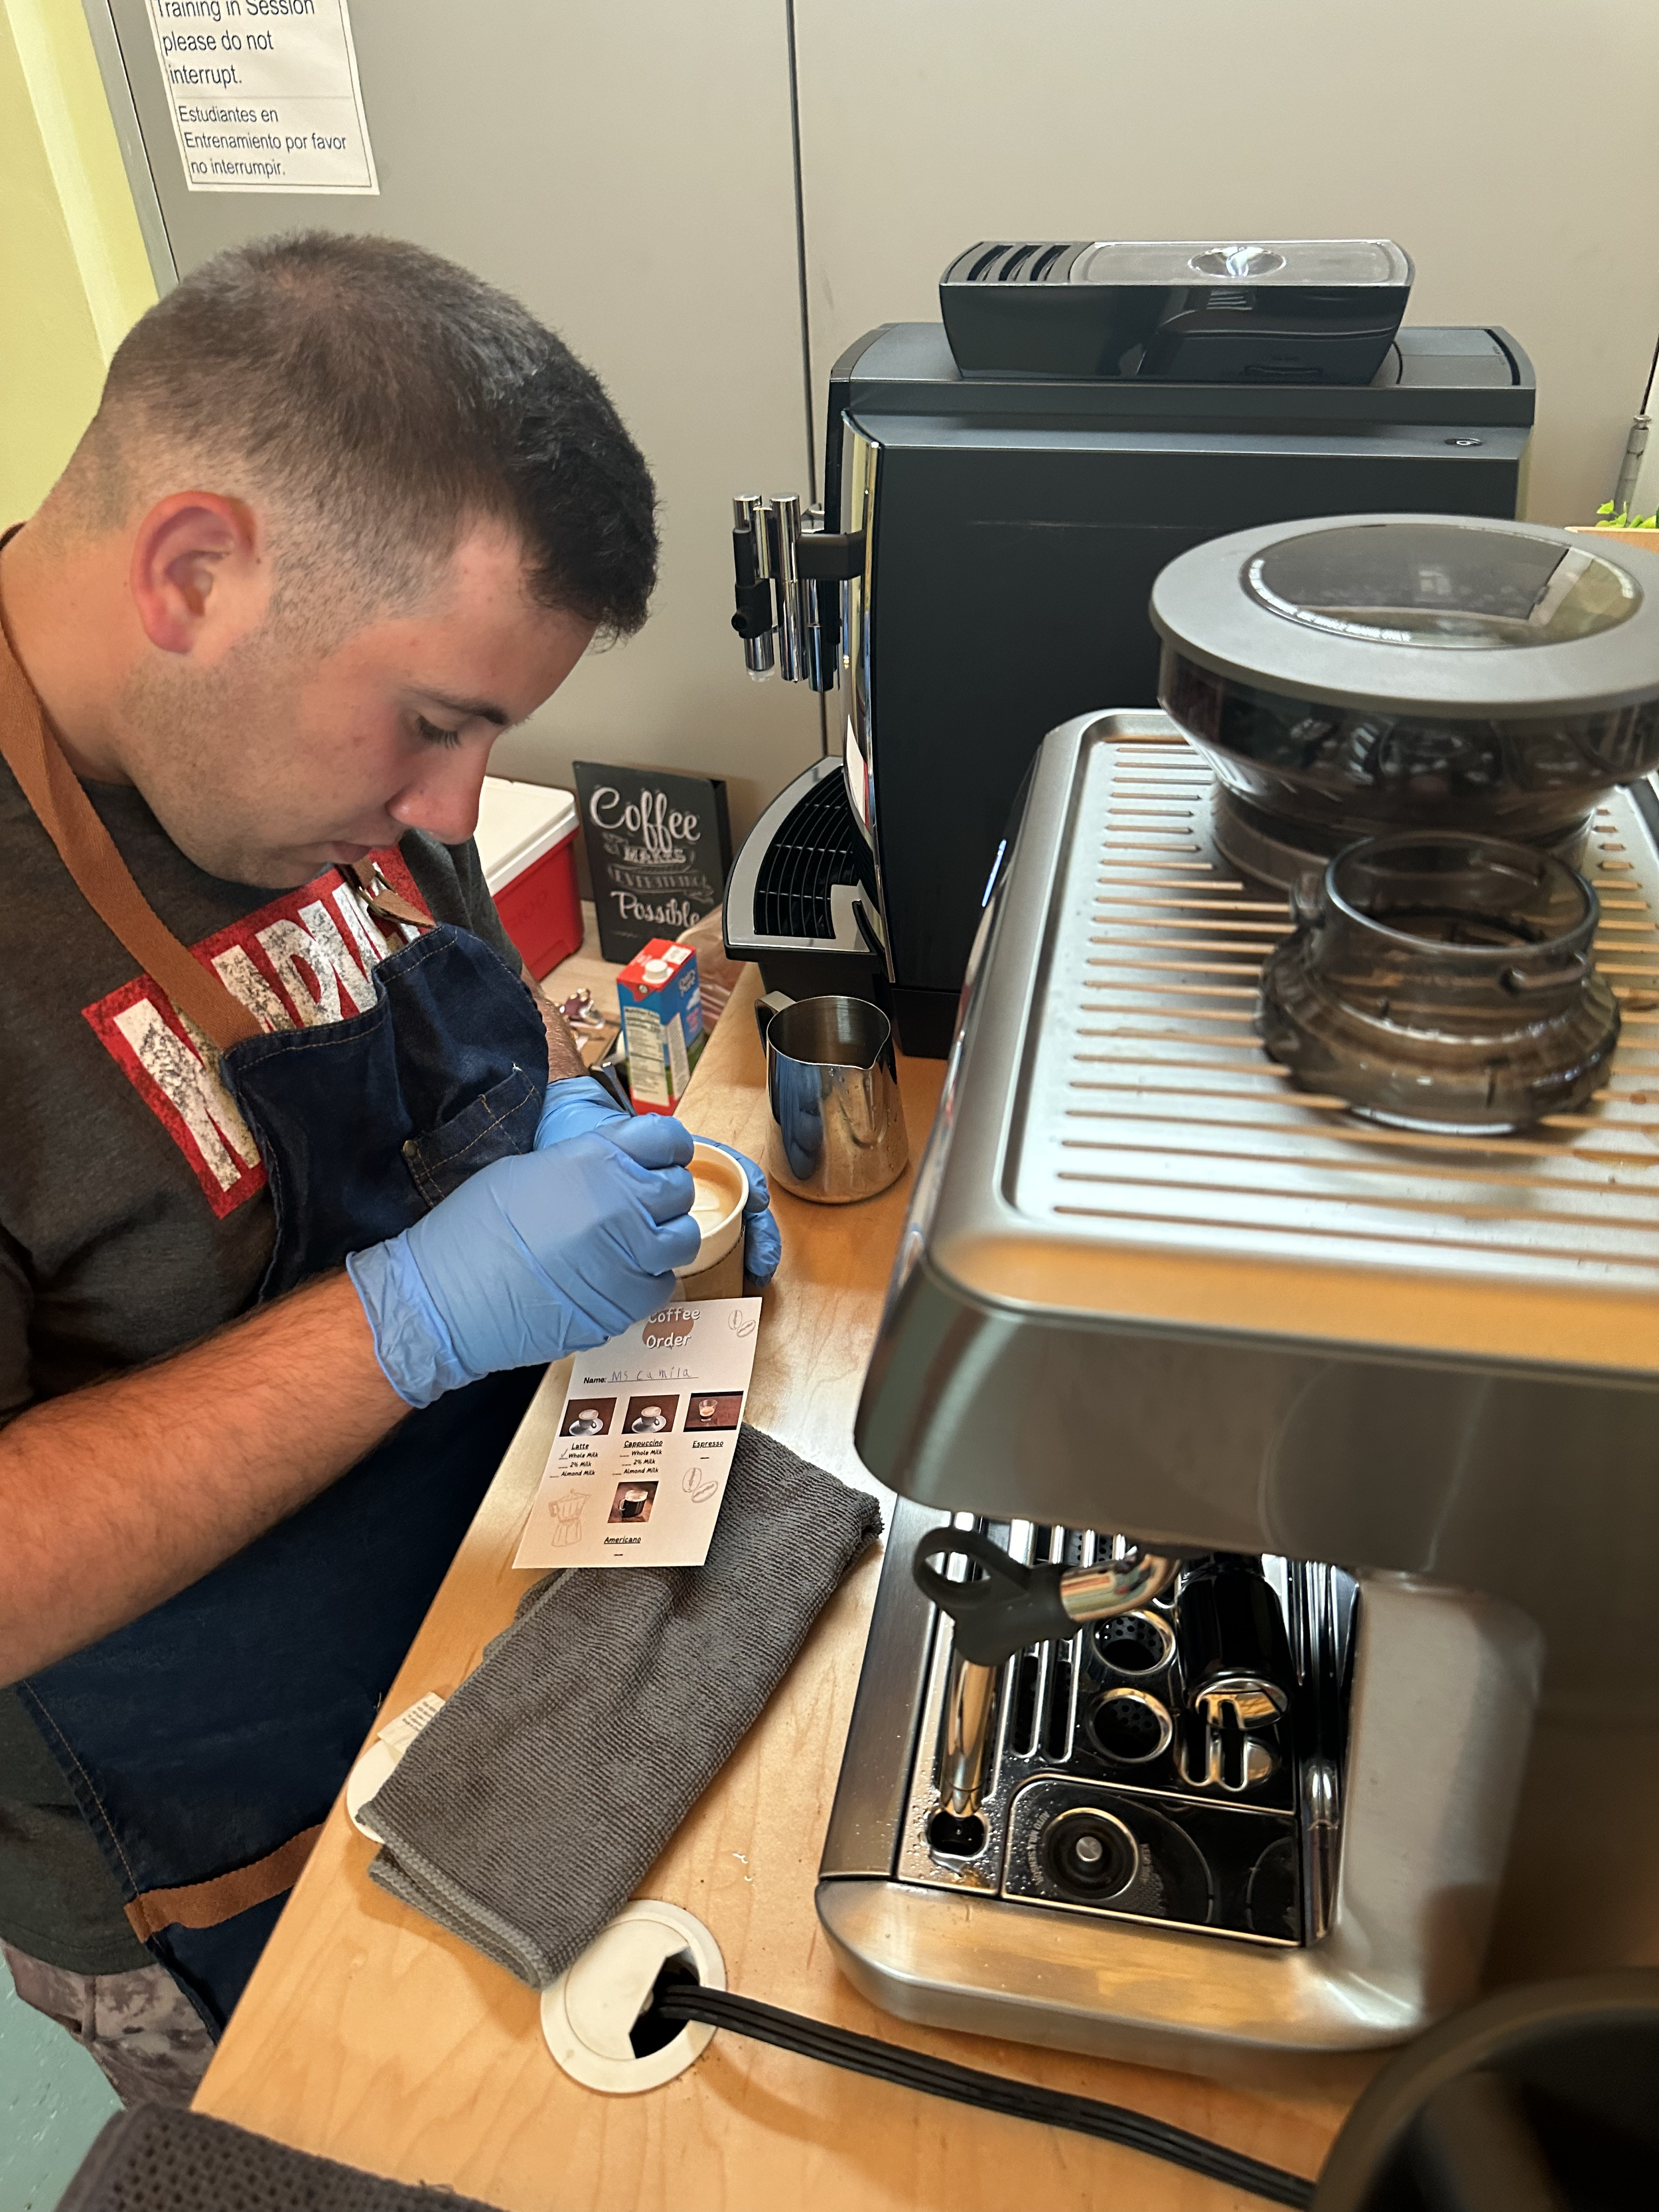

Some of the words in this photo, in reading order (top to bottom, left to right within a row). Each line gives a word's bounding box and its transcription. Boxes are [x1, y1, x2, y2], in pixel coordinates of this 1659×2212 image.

[157, 0, 221, 21] Training
[227, 0, 241, 16] in
[247, 0, 315, 16] Session
[163, 31, 216, 56] please
[222, 31, 242, 51] do
[247, 31, 274, 51] not
[169, 64, 242, 89] interrupt.
[179, 106, 257, 123] Estudiantes
[261, 110, 279, 122] en
[184, 132, 281, 150] Entrenamiento
[285, 136, 307, 153] por
[311, 133, 347, 150] favor
[191, 161, 207, 175] no
[210, 159, 286, 179] interrumpir.
[590, 786, 701, 853] Coffee
[611, 891, 700, 928] Possible
[649, 1307, 700, 1323] Coffee
[646, 1333, 691, 1349] Order
[624, 1439, 663, 1448] Cappuccino
[604, 1535, 641, 1544] Americano
